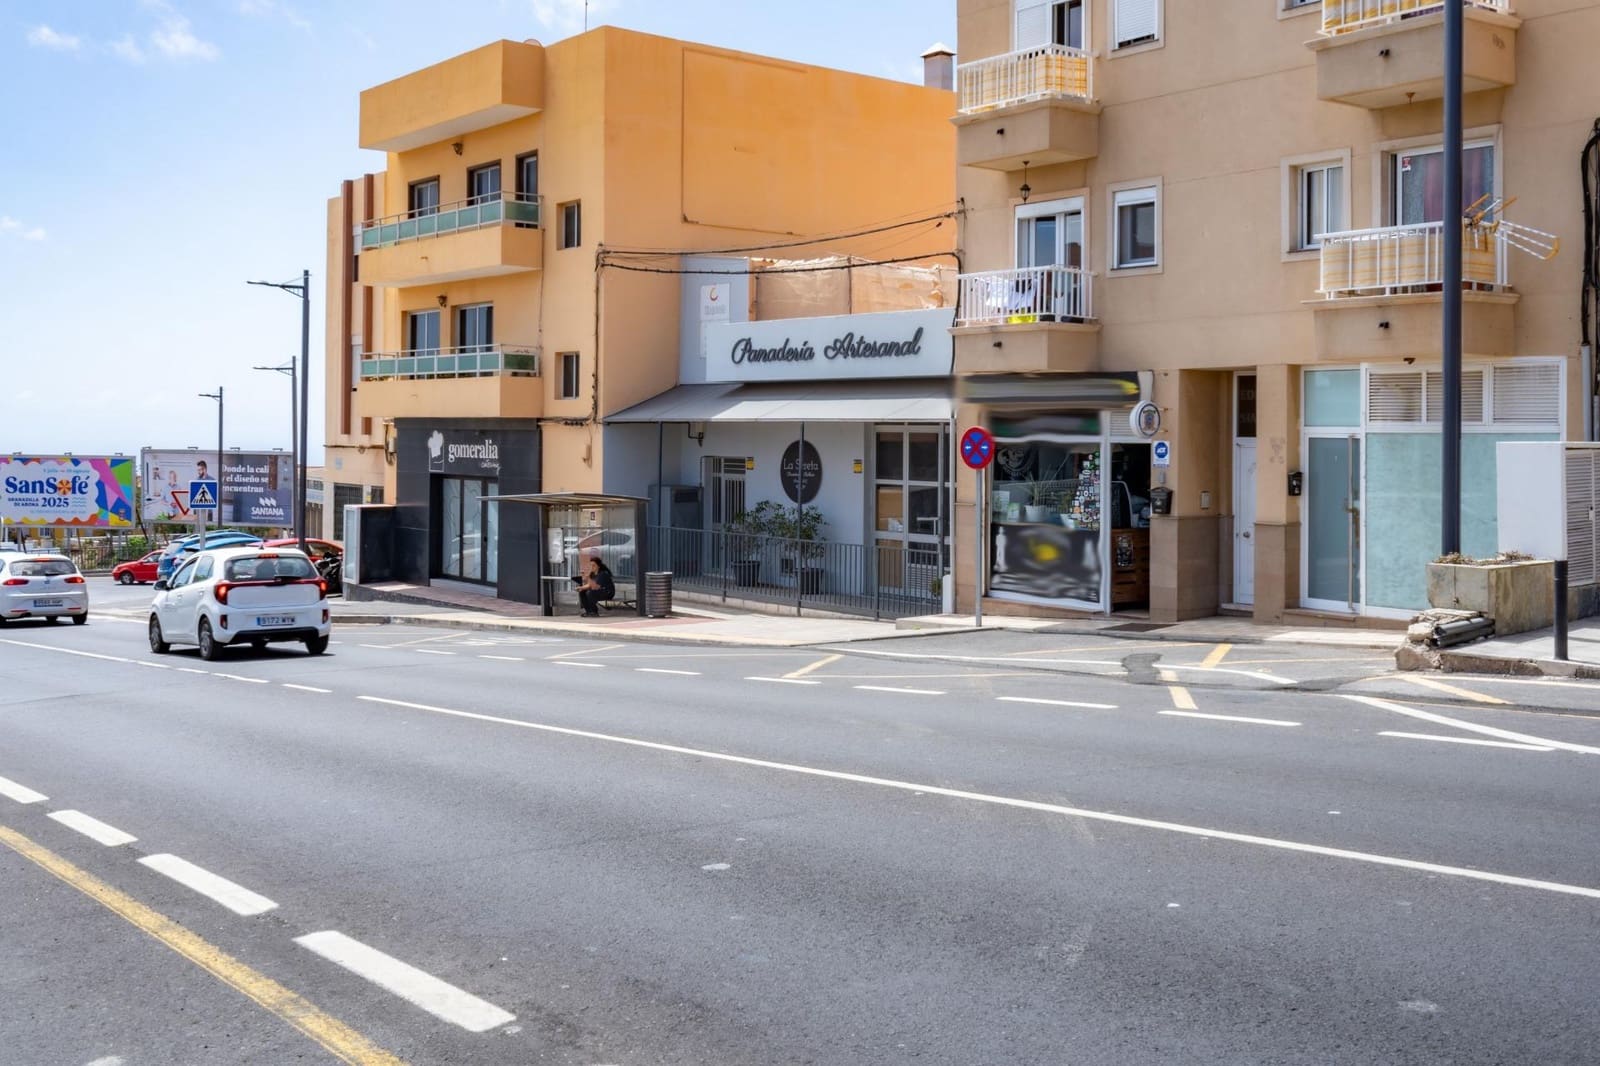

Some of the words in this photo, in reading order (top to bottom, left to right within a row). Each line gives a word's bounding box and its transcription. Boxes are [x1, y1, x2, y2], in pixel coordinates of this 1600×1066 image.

[731, 338, 814, 365] Panadería
[824, 327, 923, 360] Artesanal
[448, 439, 498, 463] gomeralia
[222, 464, 246, 473] Donde
[247, 465, 255, 473] la
[783, 458, 794, 470] La
[226, 474, 232, 482] el
[234, 474, 260, 483] diseño
[5, 475, 90, 495] SanSofé
[41, 497, 70, 508] 2025
[251, 507, 284, 516] SANTANA
